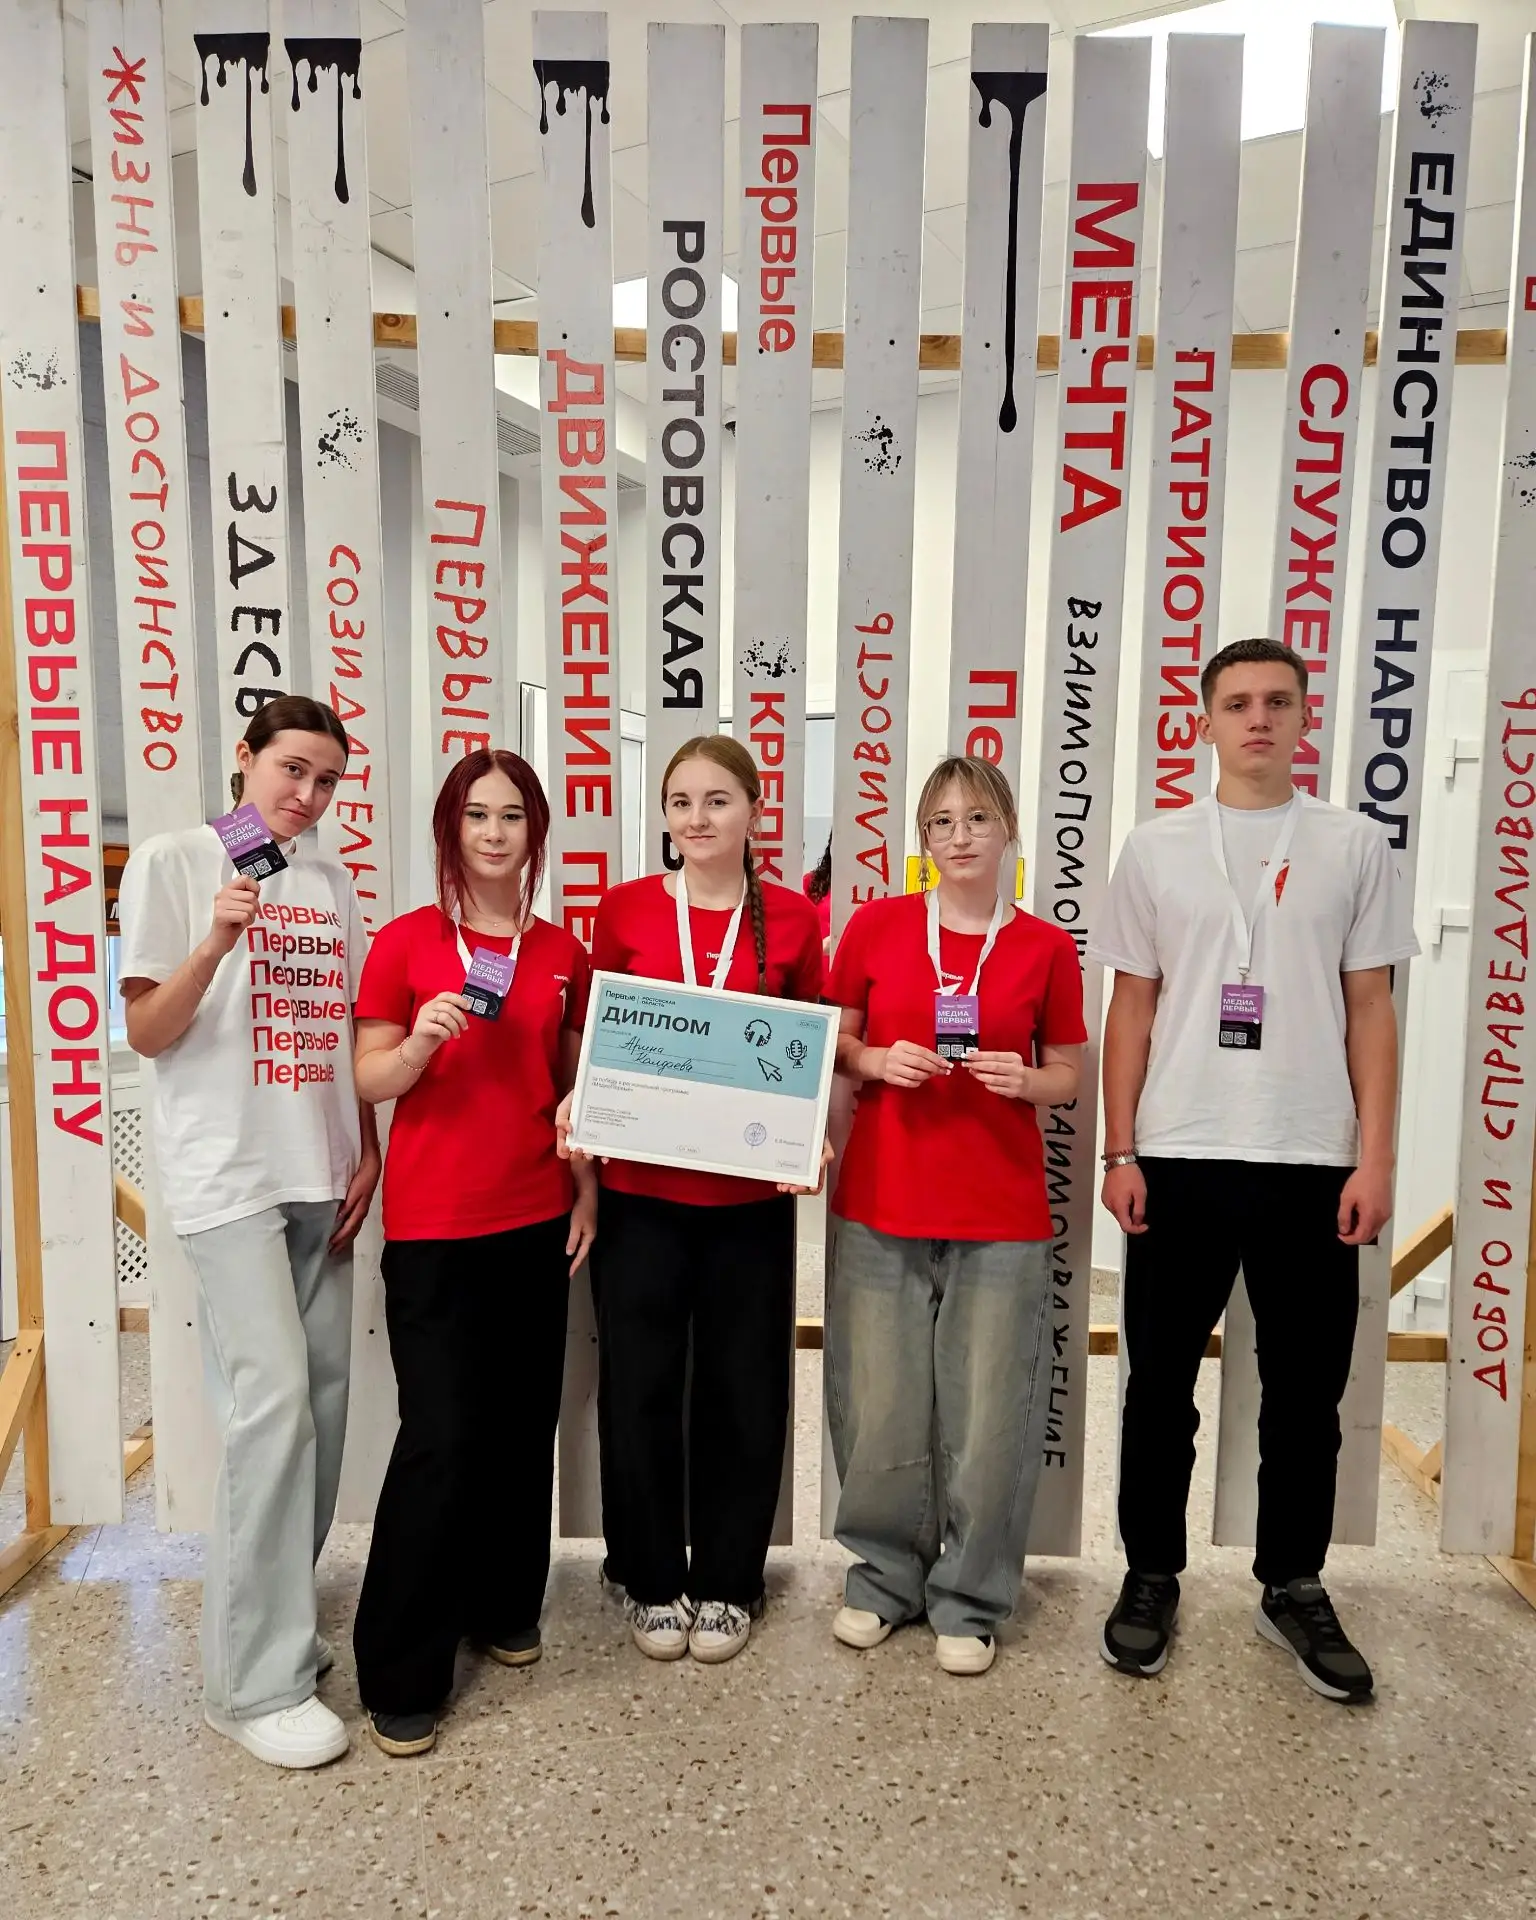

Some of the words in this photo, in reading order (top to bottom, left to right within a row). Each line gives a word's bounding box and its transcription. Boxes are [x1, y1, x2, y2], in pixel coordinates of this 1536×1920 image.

[102, 47, 158, 267] ЖИЗНЬ
[745, 104, 811, 353] Первые
[122, 301, 154, 337] И
[1060, 183, 1139, 533] МЕЧТА
[1381, 152, 1455, 569] ЕДИНСТВО
[662, 220, 706, 709] РОСТОВСКАЯ
[120, 354, 184, 772] ДОСТОИНСТВО
[1154, 351, 1215, 809] ПАТРИОТИЗМ
[227, 471, 287, 718] ЗДЕСЬ
[546, 349, 613, 818] ДВИЖЕНИЕ
[16, 431, 84, 776] ПЕРВЫЕ
[430, 499, 492, 754] ПЕРВЫЕ
[221, 822, 255, 842] МЕДИА
[225, 826, 263, 849] ПЕРВЫЕ
[39, 799, 93, 906] НА
[1481, 687, 1536, 1141] СПРАВЕДЛИВОСТЬ
[246, 926, 345, 961] Первые
[249, 959, 344, 993] Первые
[470, 968, 505, 986] ПЕРВЫЕ
[472, 961, 503, 978] МЕДИА
[251, 992, 346, 1025] Первые
[605, 990, 636, 1001] Первые
[1222, 1004, 1258, 1013] ПЕРВЫЕ
[1223, 998, 1255, 1007] МЕДИА
[601, 1006, 711, 1036] ДИПЛОМ
[937, 1010, 970, 1018] МЕДИА
[34, 920, 104, 1147] ДОНУ
[253, 1025, 339, 1059] Первые
[253, 1059, 335, 1092] Первые
[1483, 1179, 1512, 1210] И
[1473, 1241, 1513, 1401] ДОБРО
